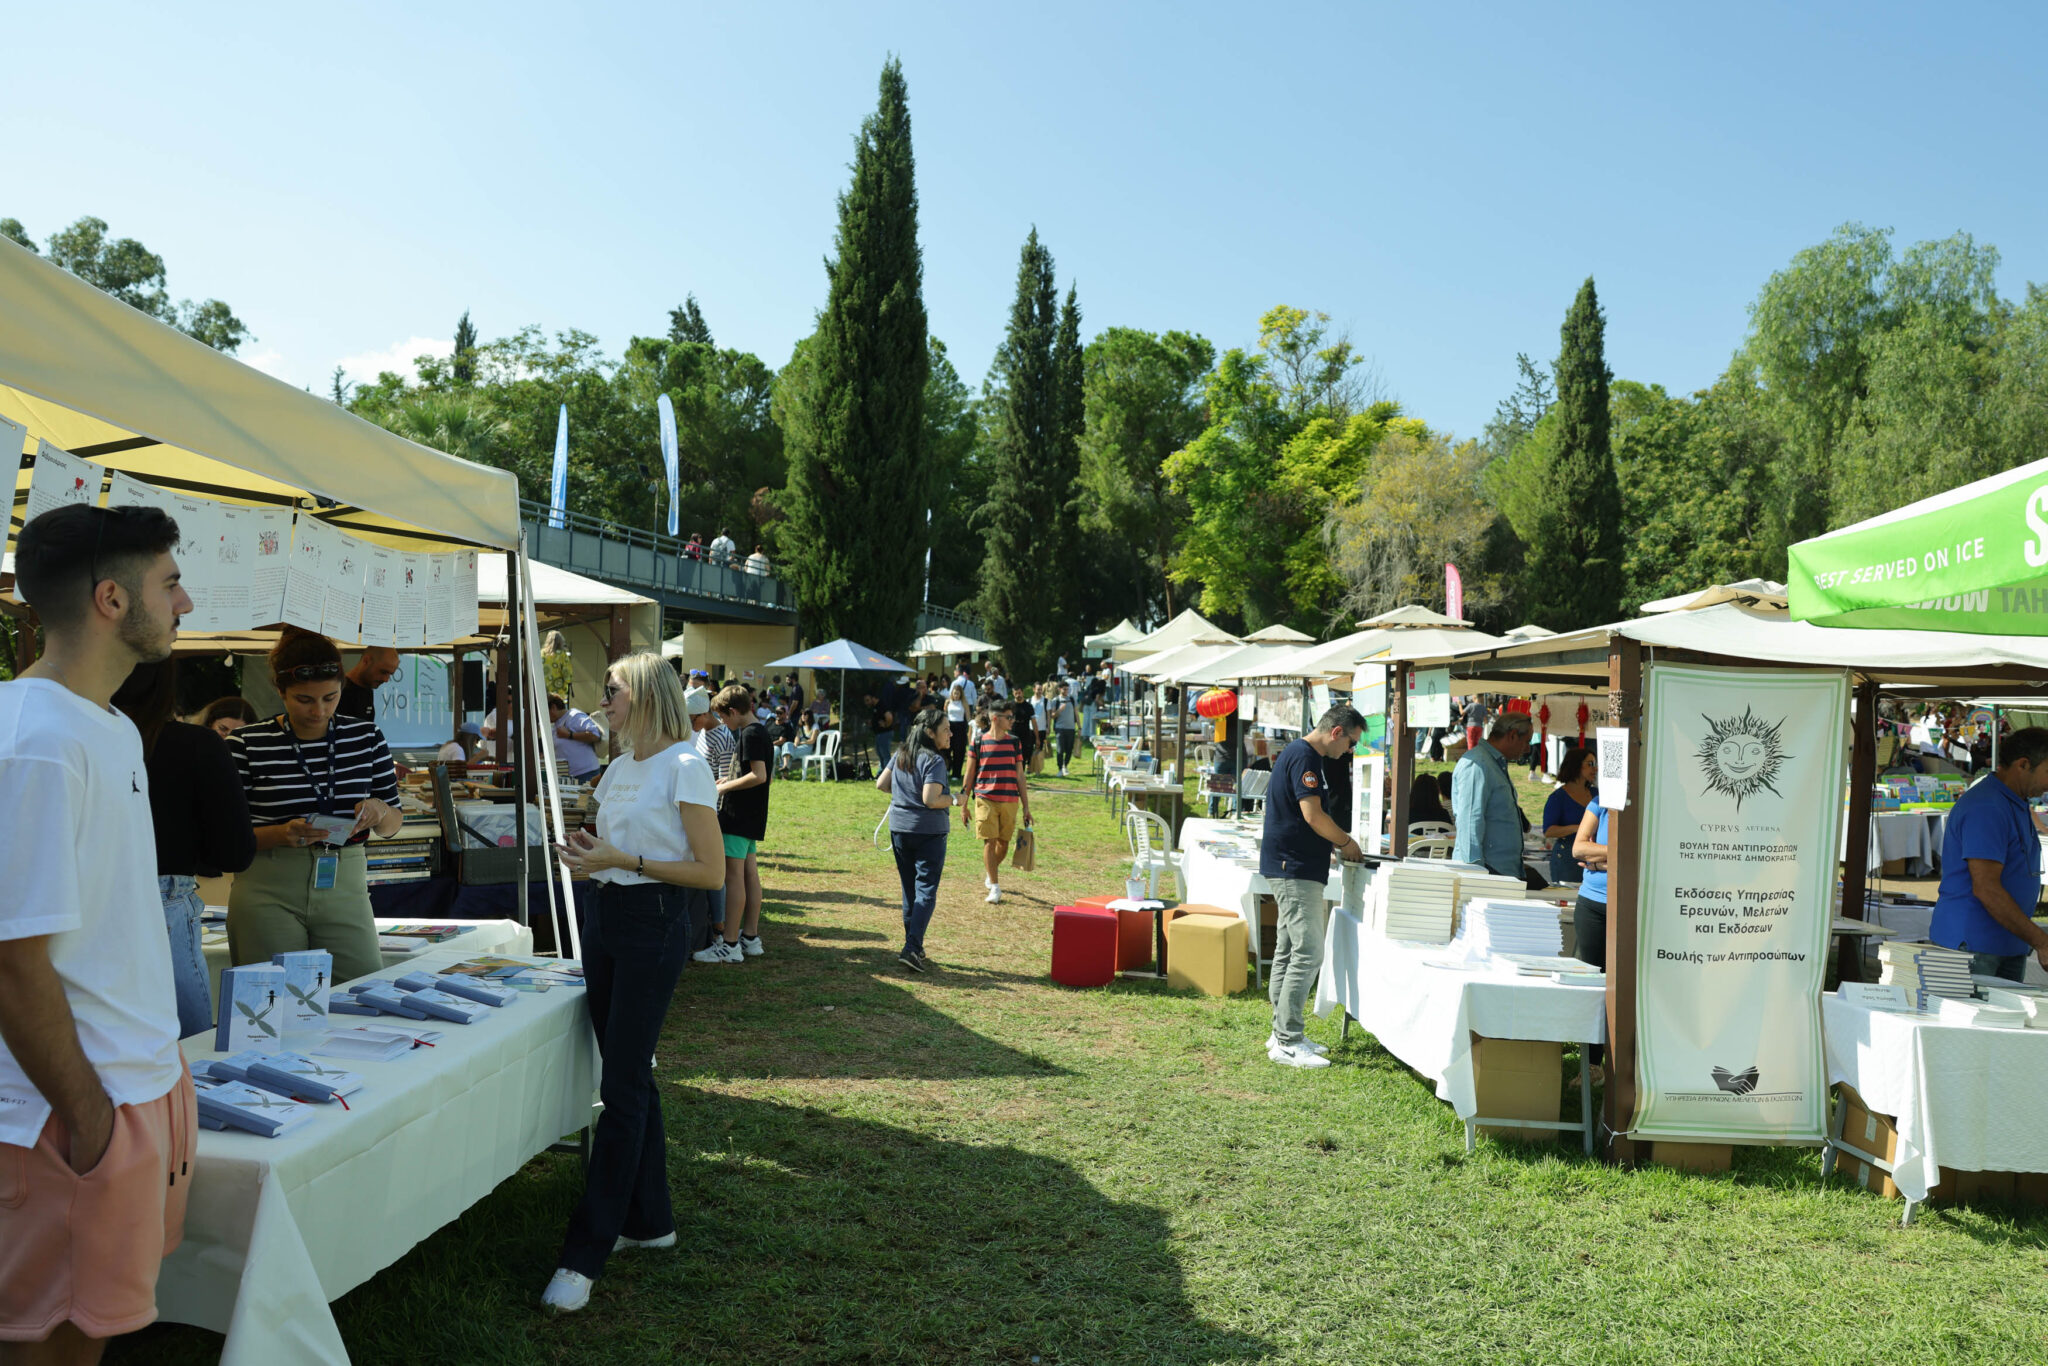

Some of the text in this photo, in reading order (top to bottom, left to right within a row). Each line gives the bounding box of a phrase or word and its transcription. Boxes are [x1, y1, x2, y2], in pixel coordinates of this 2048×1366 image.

[1814, 537, 1984, 590] BEST SERVED ON ICE
[1700, 823, 1740, 833] CYPRVS
[1679, 842, 1798, 853] ΒΟΥΛΗ ΤΩΝ ΑΝΤΙΠΡΟΣΩΠΩΝ
[1679, 852, 1797, 862] ΤΗΣ ΚΥΠΡΙΑΚΗΣ ΔΗΜΟΚΡΑΤΙΑΣ
[1675, 887, 1795, 903] Εκδόσεις Υπηρεσίας
[1680, 904, 1788, 919] Ερευνών, Μελετών
[1695, 922, 1773, 934] και Εκδόσεων
[1657, 949, 1806, 964] Βουλής των Αντιπροσώπων
